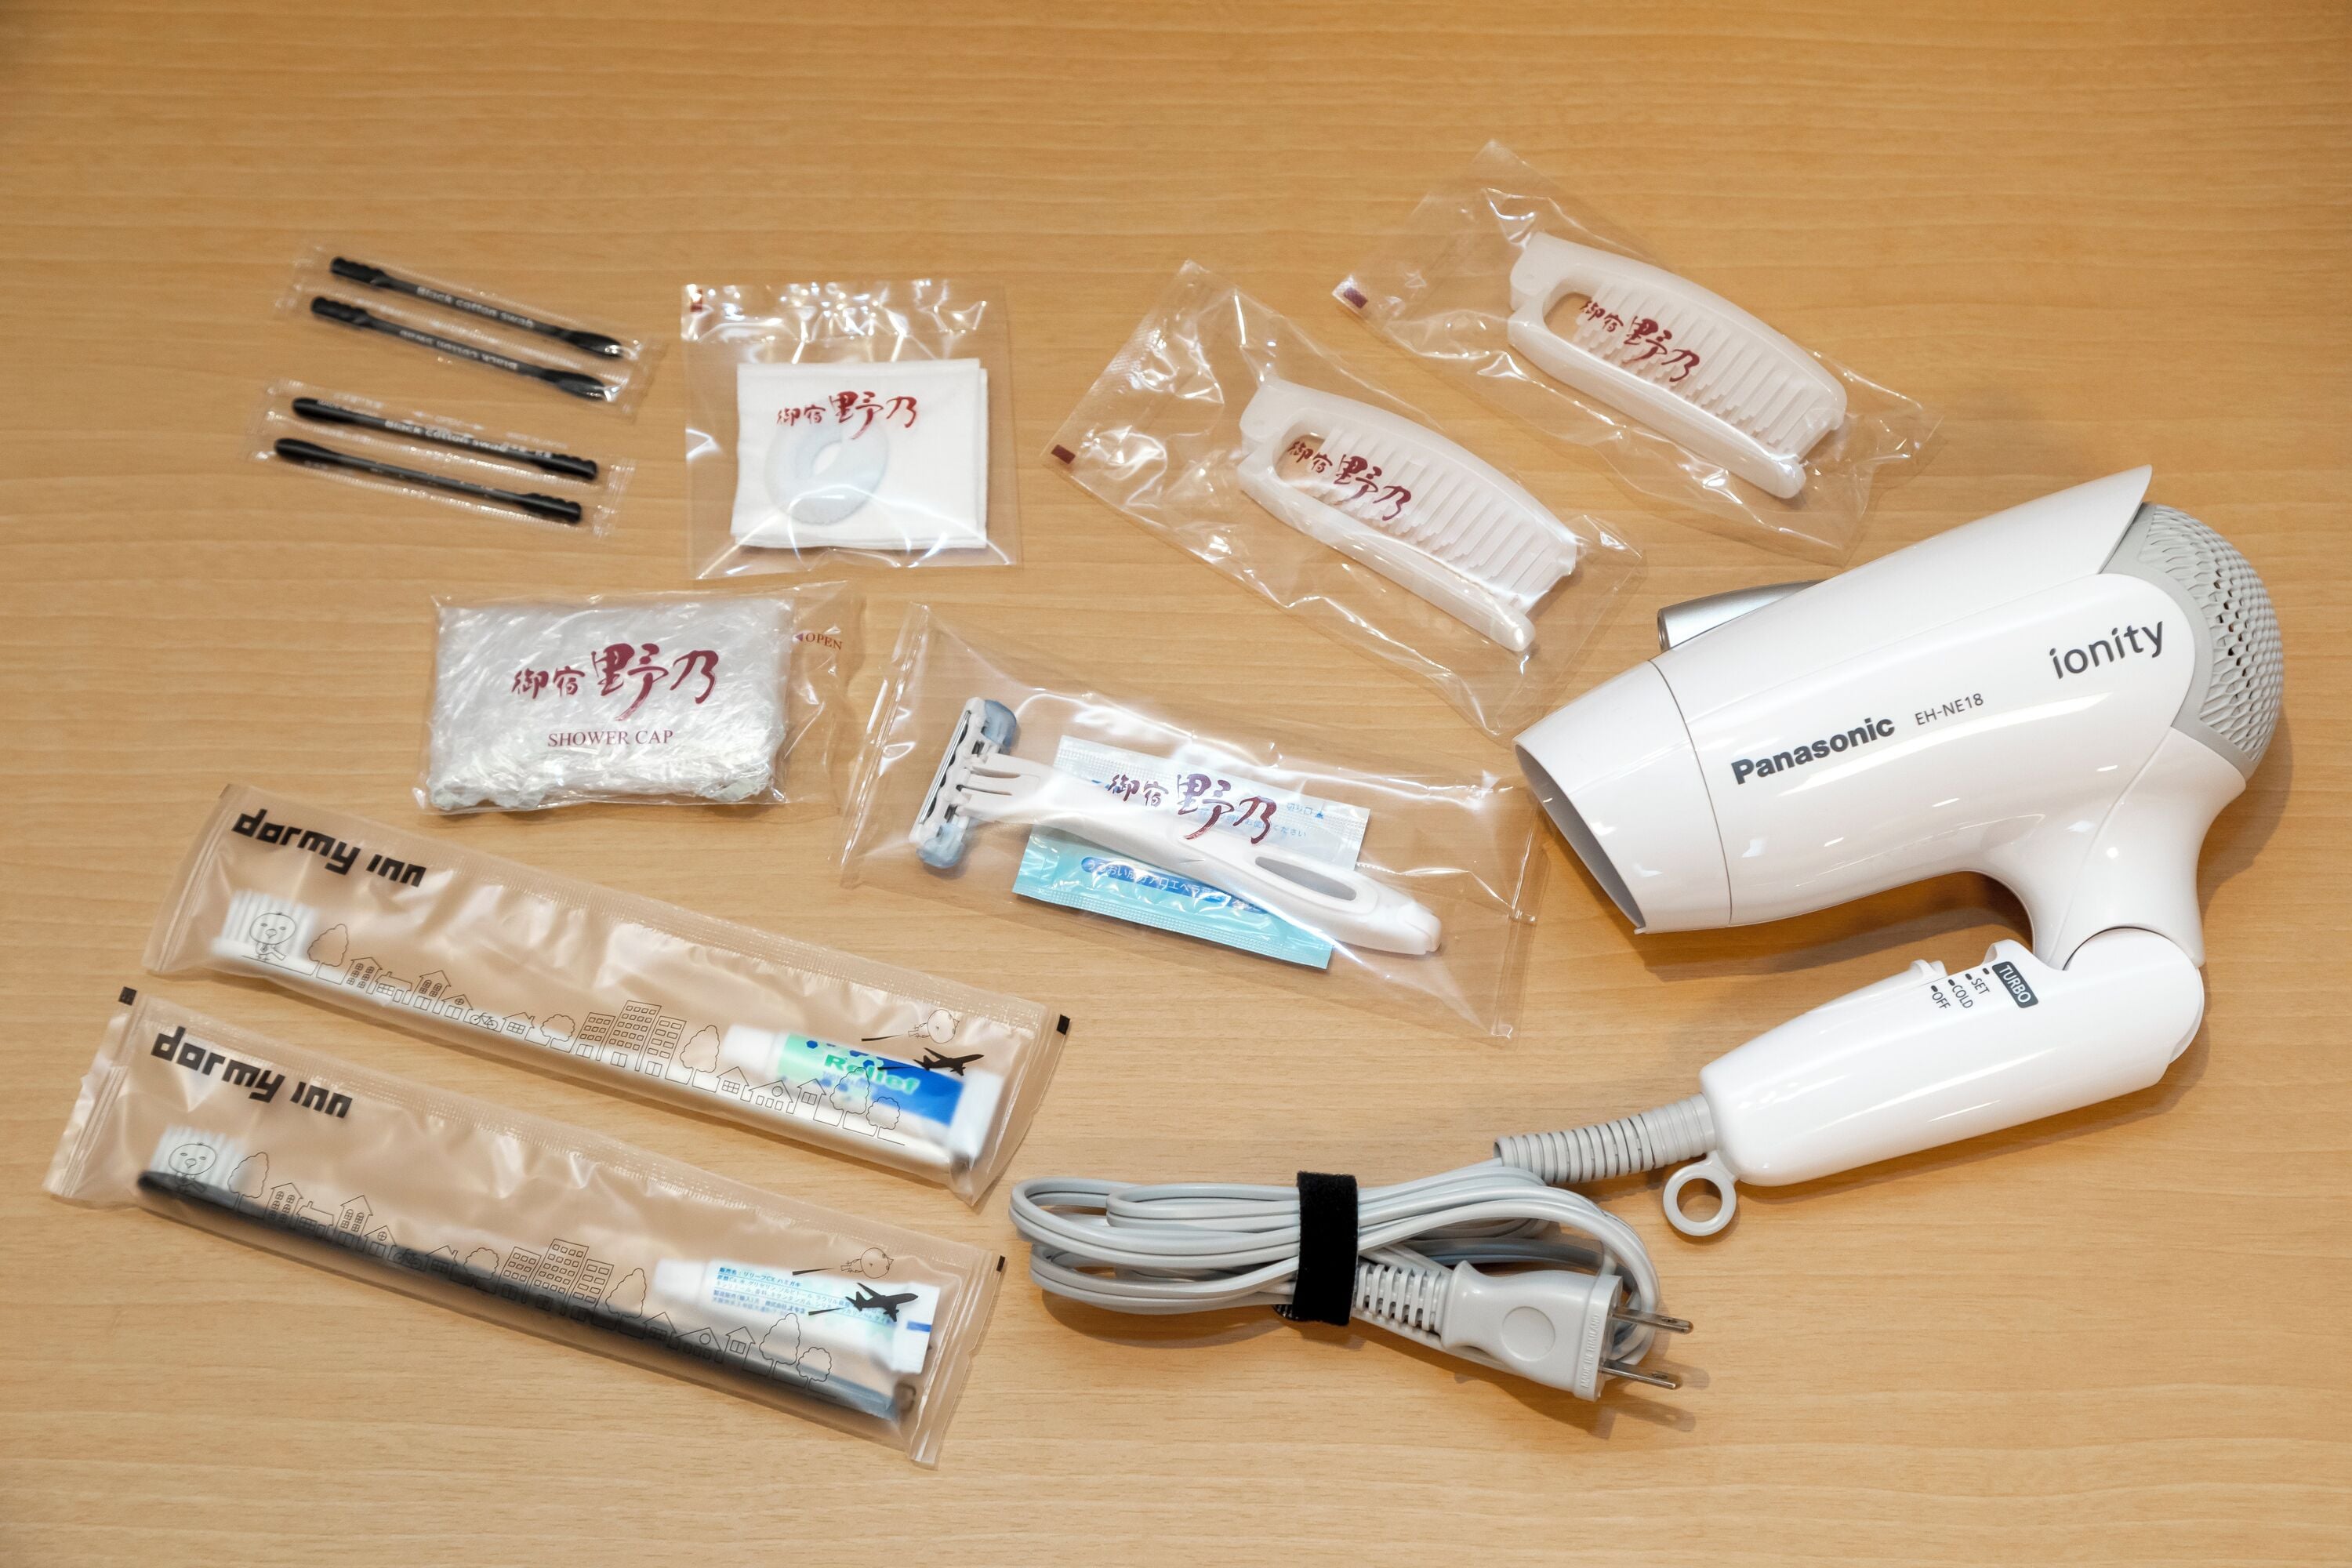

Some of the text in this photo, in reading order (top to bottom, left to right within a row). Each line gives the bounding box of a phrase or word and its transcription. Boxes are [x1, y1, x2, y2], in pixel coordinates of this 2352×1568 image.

[416, 286, 535, 328] Black cotton swab
[805, 632, 843, 651] OPEN
[2049, 620, 2164, 680] ionity
[547, 729, 674, 747] SHOWER CAP
[1730, 692, 1984, 786] Panasonic EH-NE18
[231, 808, 427, 887] dormy inn
[1931, 991, 1951, 1009] OFF
[1951, 984, 1974, 1009] COLD
[1970, 977, 1991, 995] SET
[1998, 964, 2032, 1004] TURBO
[151, 1025, 354, 1120] dormy inn
[824, 1054, 922, 1096] Relief
